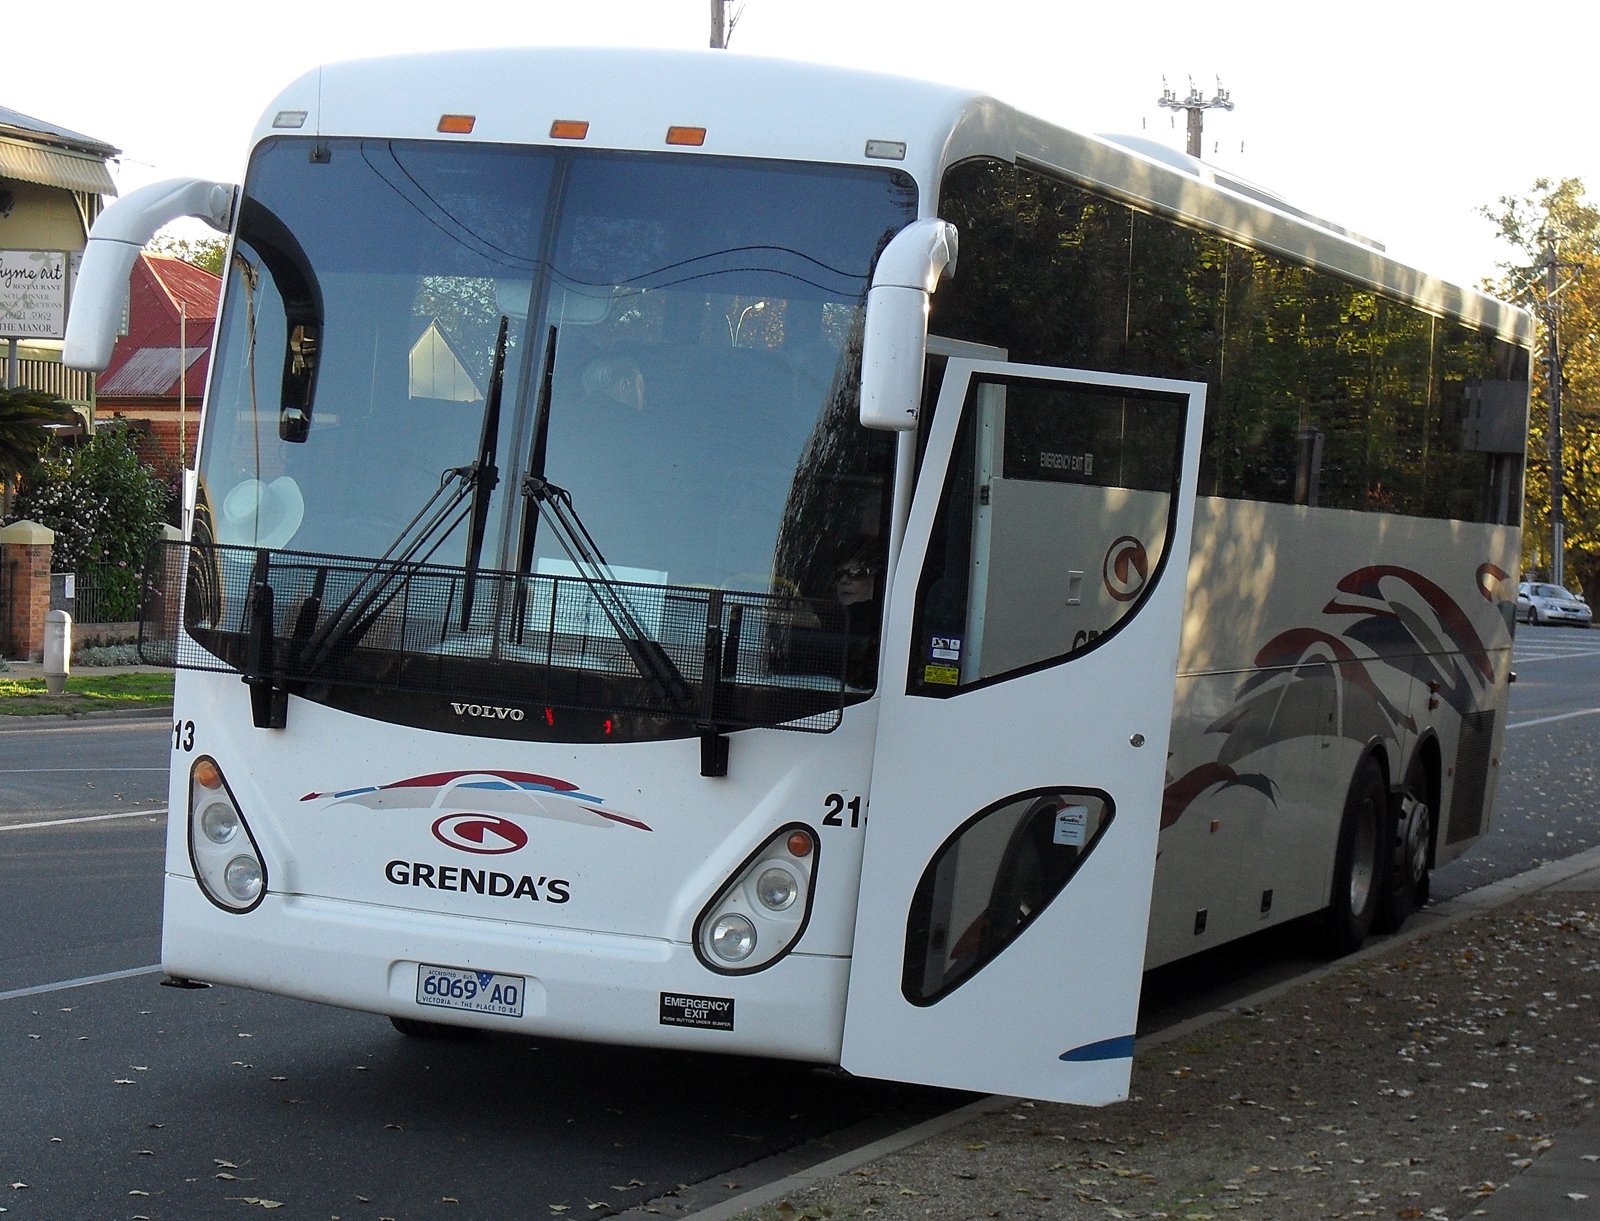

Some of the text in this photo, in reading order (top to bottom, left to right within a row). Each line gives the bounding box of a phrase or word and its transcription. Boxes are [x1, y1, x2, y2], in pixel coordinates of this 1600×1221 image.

[19, 323, 52, 333] MANOR
[1072, 456, 1084, 470] EXIT
[451, 702, 525, 721] VOLVO
[175, 719, 195, 752] 13
[822, 793, 869, 828] 21
[385, 860, 570, 903] GRENDA'S
[424, 975, 477, 1000] 6069
[422, 996, 451, 1005] VICTORIA
[664, 996, 730, 1011] EMERGENCY
[684, 1008, 709, 1019] EXIT
